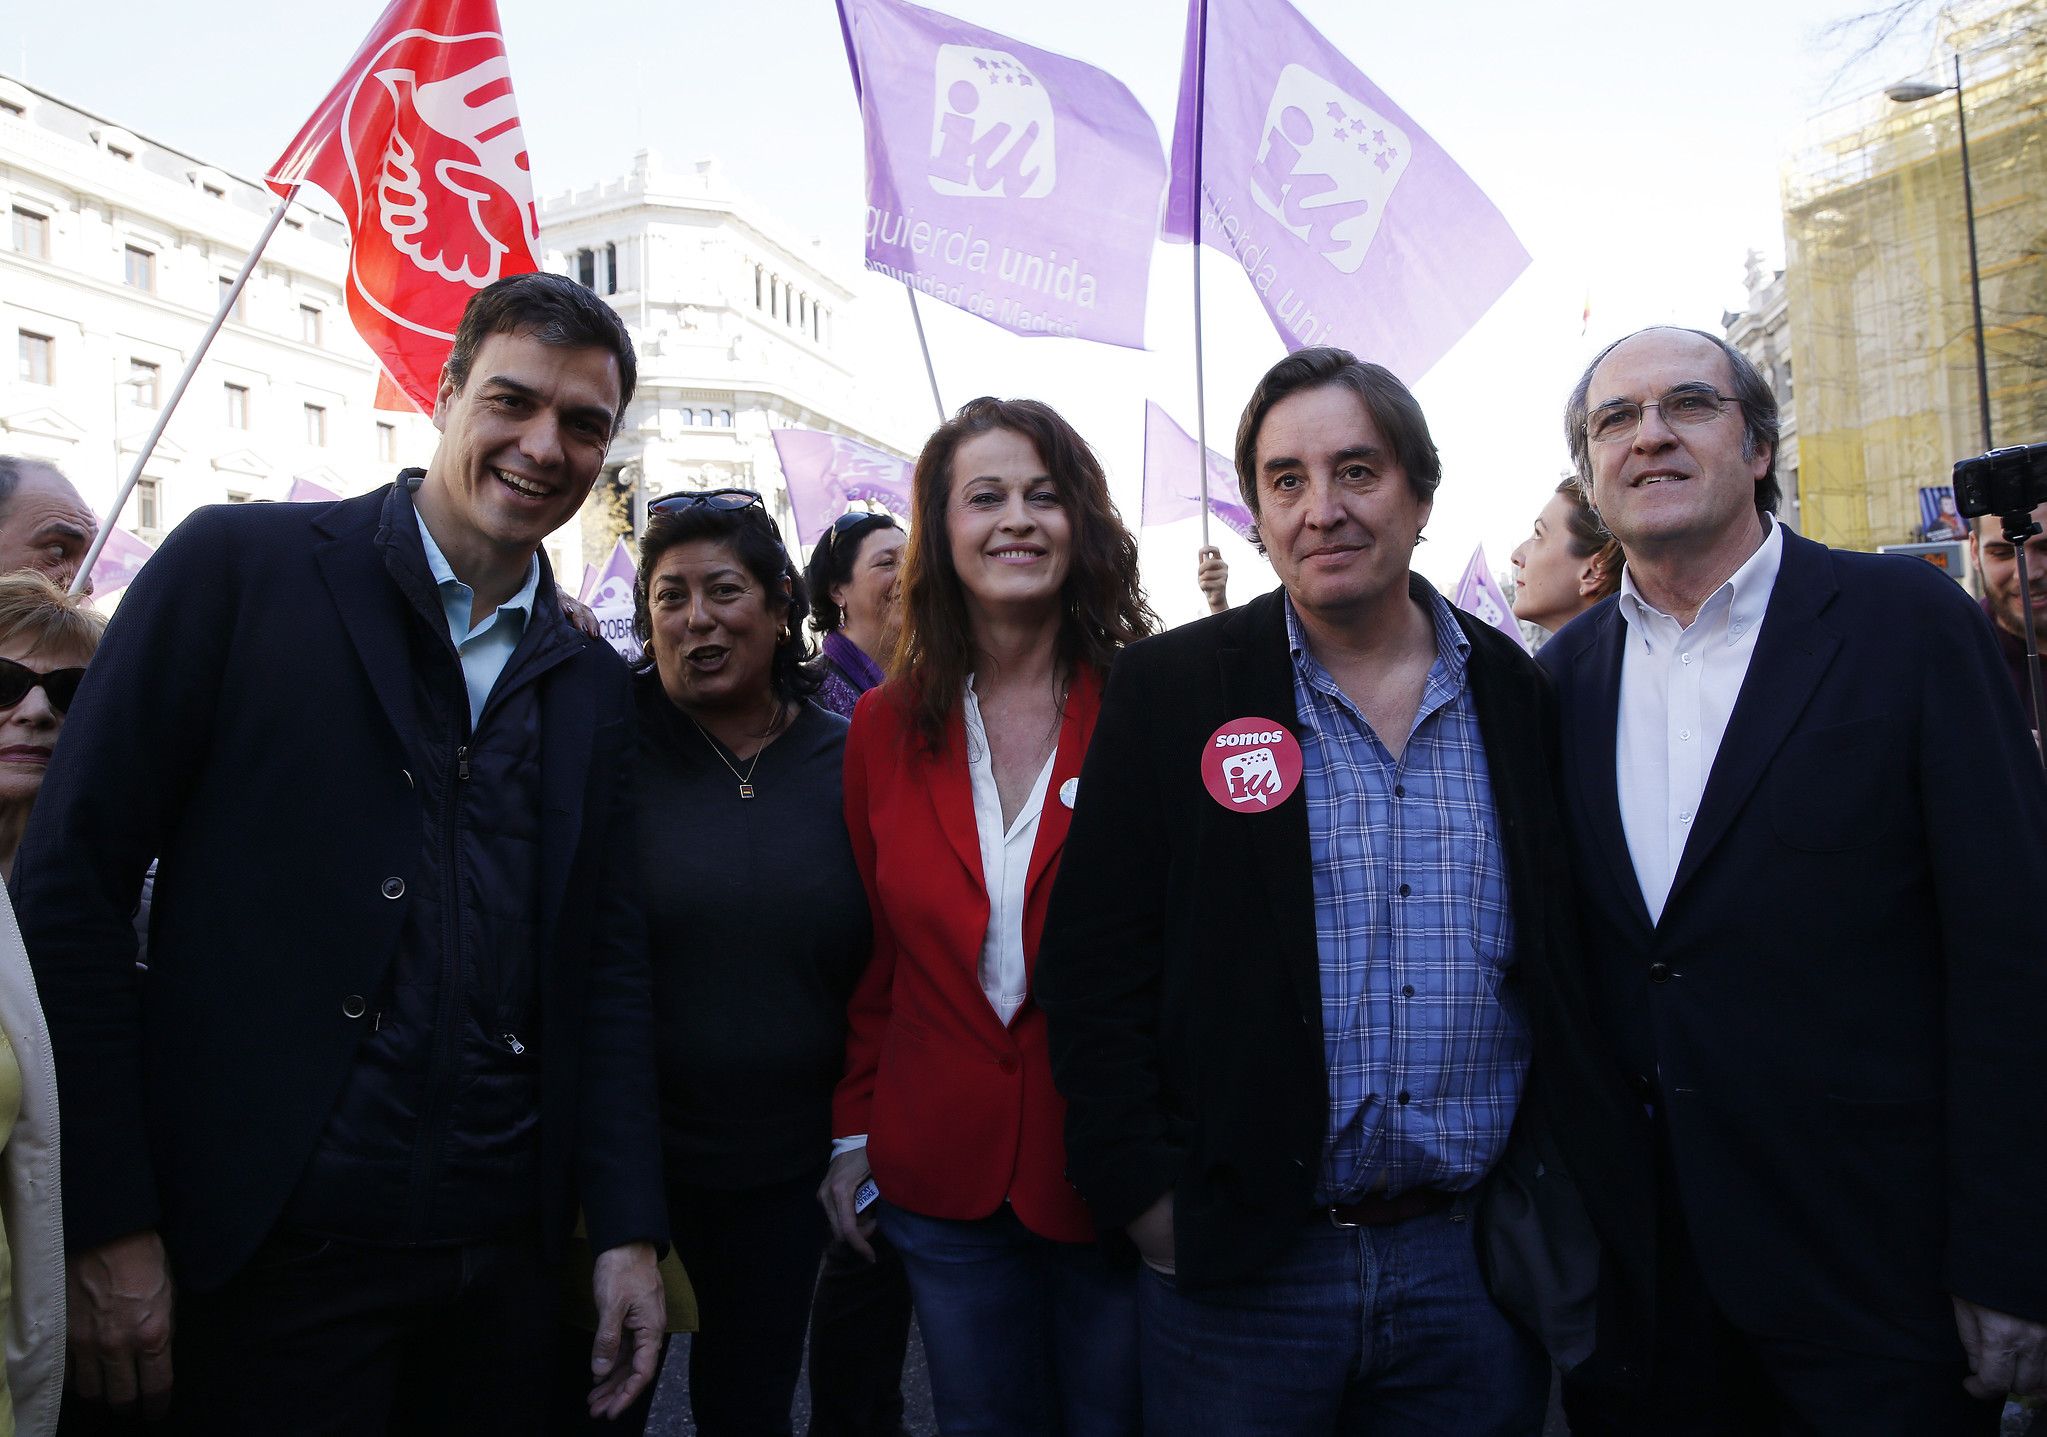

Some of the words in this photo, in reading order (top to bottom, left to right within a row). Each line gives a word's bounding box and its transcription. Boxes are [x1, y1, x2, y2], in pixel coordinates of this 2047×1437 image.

[928, 80, 1040, 198] iu
[999, 247, 1098, 310] unida
[967, 288, 996, 318] de
[999, 300, 1079, 338] Madrid
[1215, 730, 1283, 748] somos
[1230, 766, 1275, 798] iu
[857, 1189, 876, 1206] STRIKE
